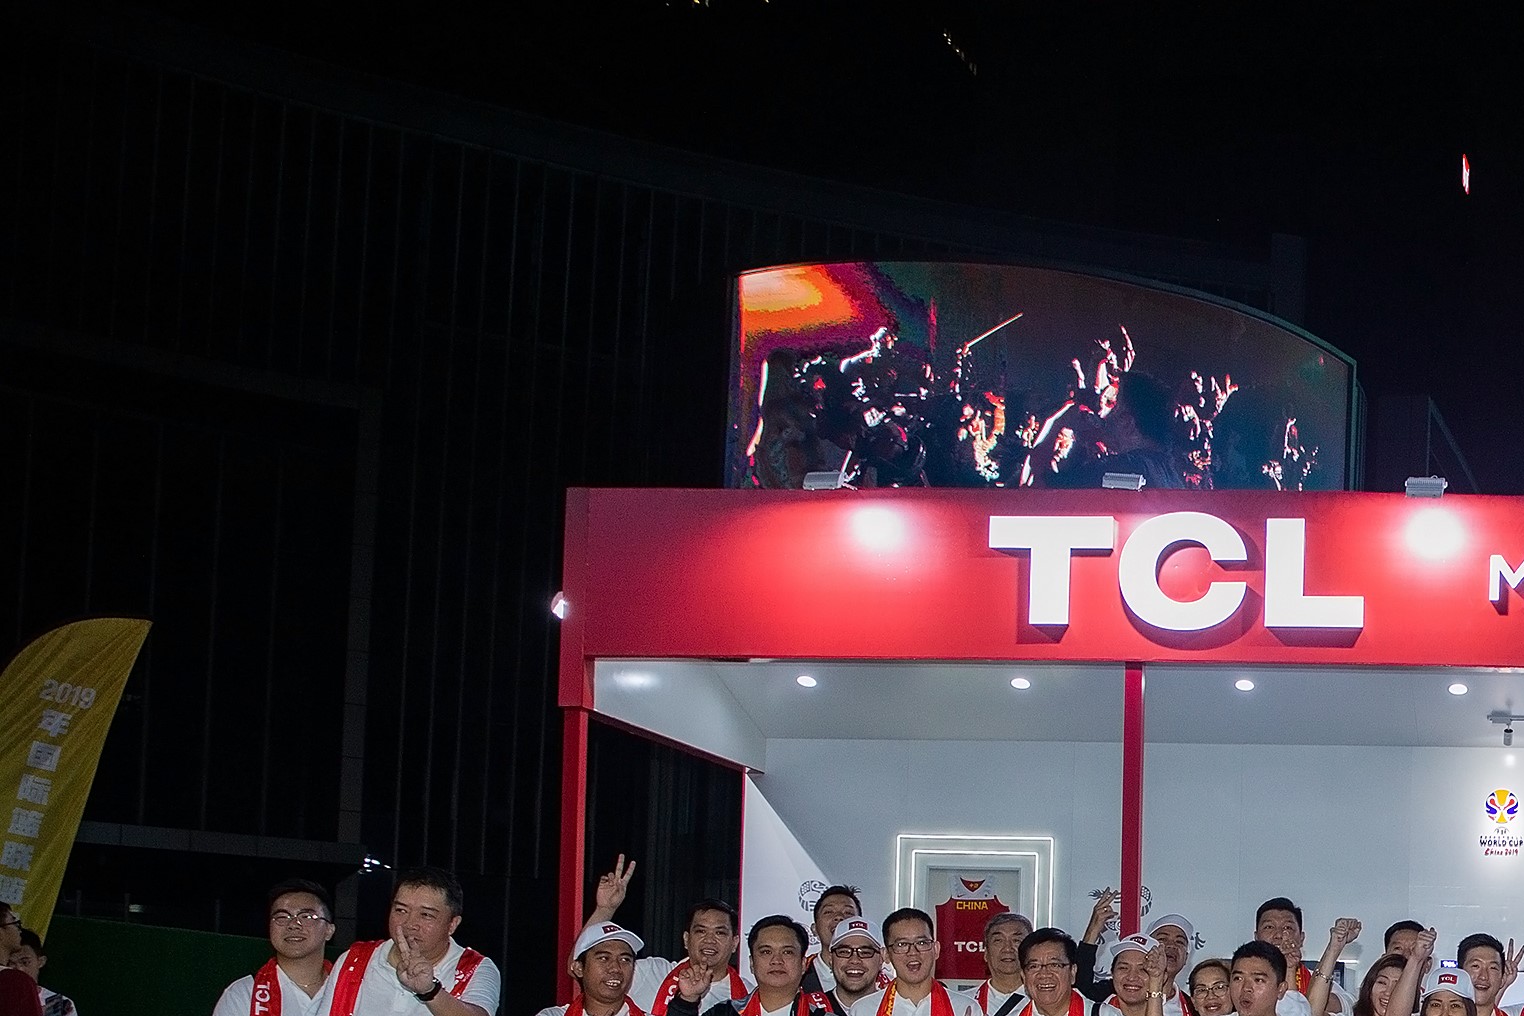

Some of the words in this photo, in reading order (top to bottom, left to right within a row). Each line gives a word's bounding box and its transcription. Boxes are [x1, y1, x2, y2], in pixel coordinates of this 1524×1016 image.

[988, 512, 1364, 631] TCL
[39, 679, 96, 709] 2019
[1479, 839, 1507, 847] WORLD
[1508, 839, 1523, 847] CUP
[956, 901, 989, 910] CHINA
[255, 981, 271, 1016] TCL
